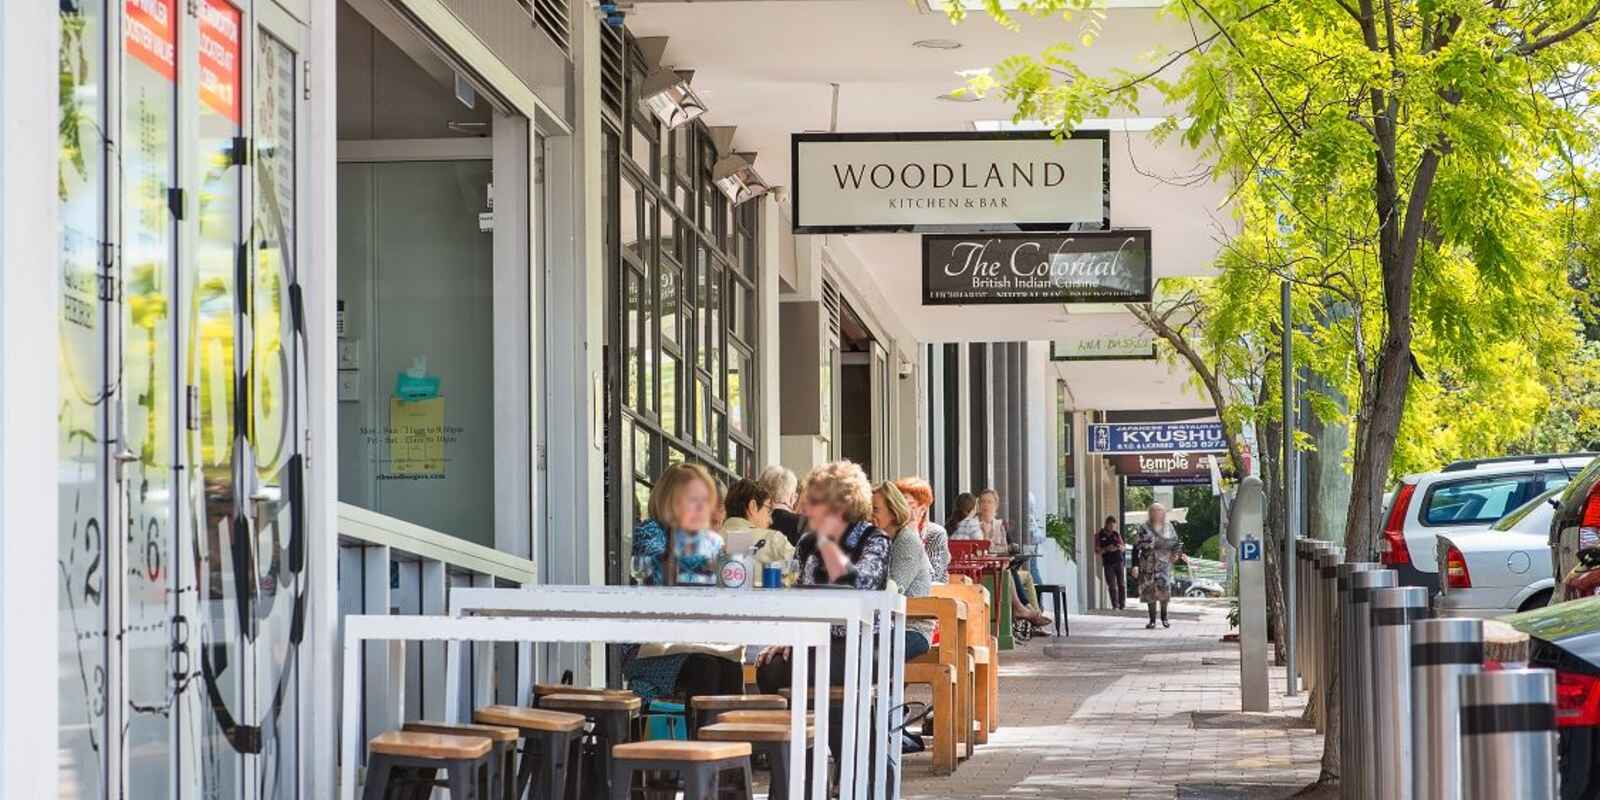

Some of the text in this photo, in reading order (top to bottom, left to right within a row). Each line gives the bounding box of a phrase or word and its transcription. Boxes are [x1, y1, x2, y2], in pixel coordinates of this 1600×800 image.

[832, 162, 1066, 190] WOODLAND
[888, 196, 1009, 209] KITCHEN & BAR
[944, 237, 1136, 277] The Colonial
[972, 277, 1100, 289] British Indian Cuisine
[1123, 430, 1222, 442] KYUSHU
[1139, 454, 1189, 472] temple
[1244, 543, 1257, 559] P
[722, 568, 743, 581] 26
